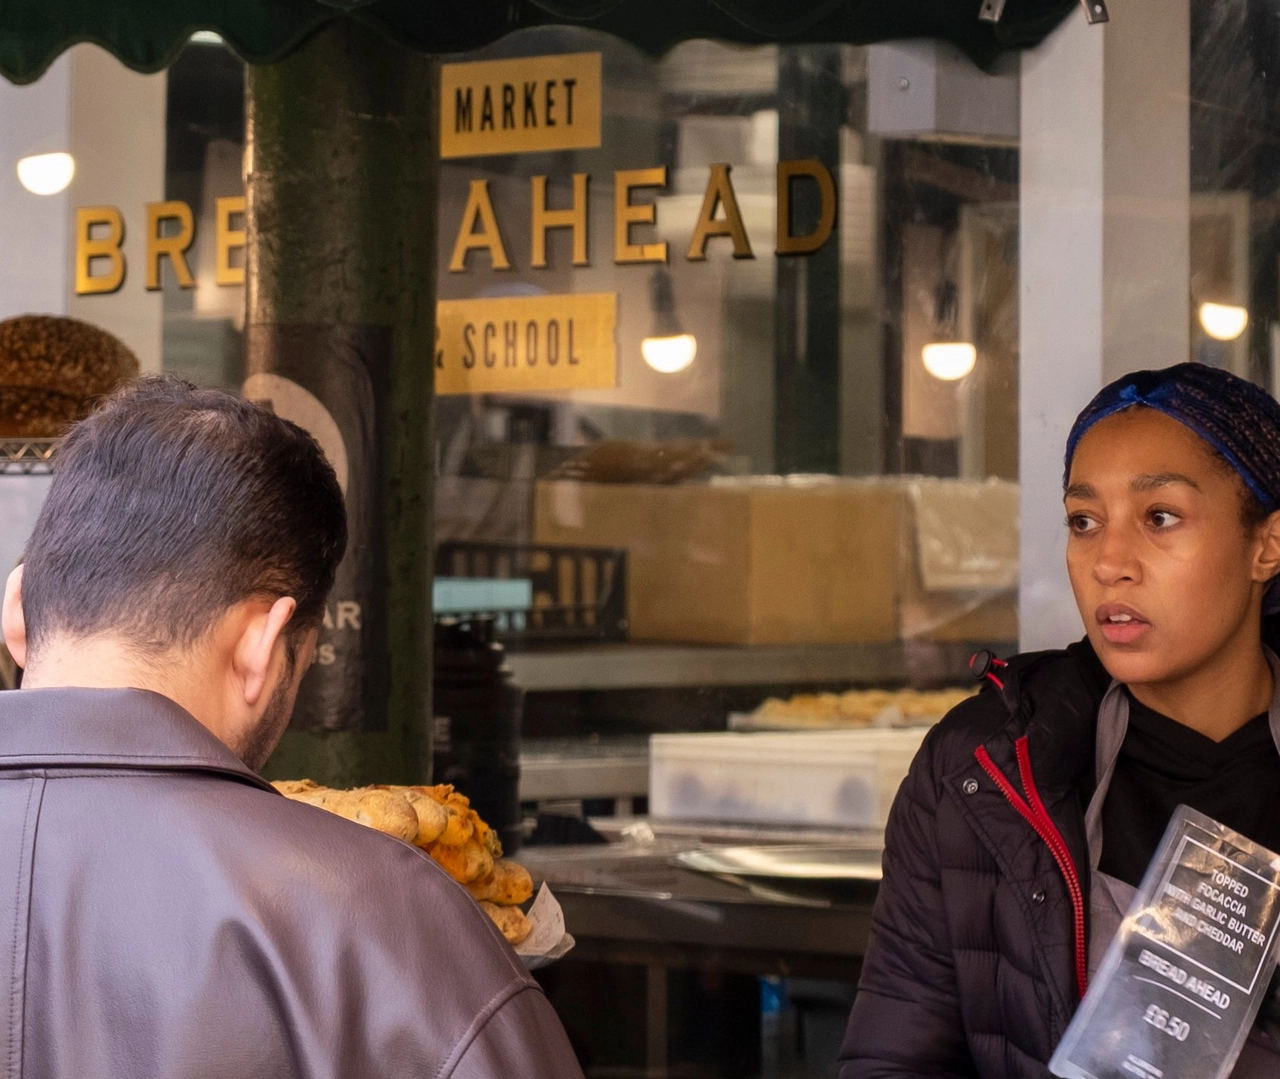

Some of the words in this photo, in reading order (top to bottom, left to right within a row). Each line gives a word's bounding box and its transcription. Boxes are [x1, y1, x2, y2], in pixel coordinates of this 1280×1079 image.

[455, 78, 577, 134] MARKET
[75, 196, 247, 296] BRE
[449, 158, 839, 273] AHEAD
[462, 317, 580, 369] SCHOOL
[1197, 881, 1247, 918] FOCACCIA
[1211, 868, 1250, 899] TOPPED
[1189, 896, 1228, 925] GARLIC
[1227, 917, 1266, 947] BUTTER
[1196, 920, 1244, 954] CHEDDAR
[1138, 948, 1188, 985] BREAD
[1183, 975, 1231, 1010] AHEAD
[1142, 1003, 1191, 1042] £6.50
